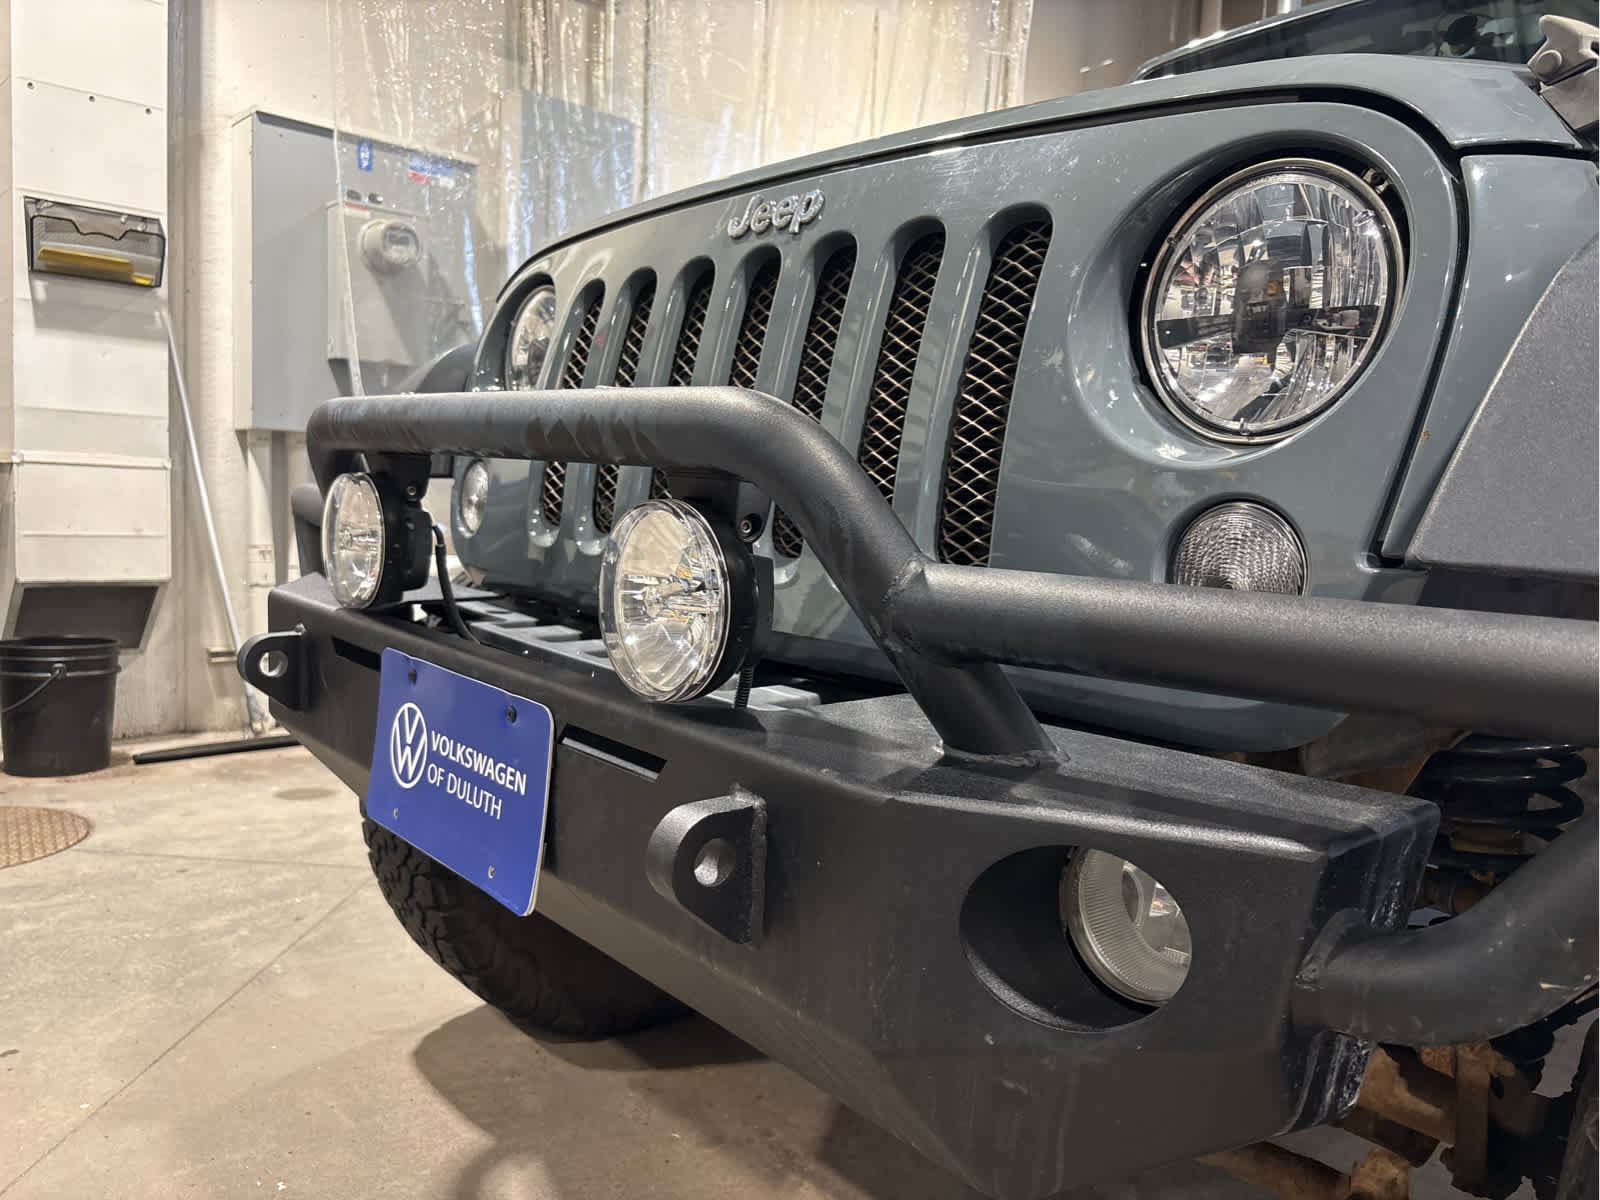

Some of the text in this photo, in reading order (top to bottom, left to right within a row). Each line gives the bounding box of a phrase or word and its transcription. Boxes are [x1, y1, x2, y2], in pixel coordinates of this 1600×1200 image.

[727, 189, 825, 239] Jeep
[427, 763, 502, 820] OF DULUTH
[431, 730, 527, 796] VOLKSWAGEN
